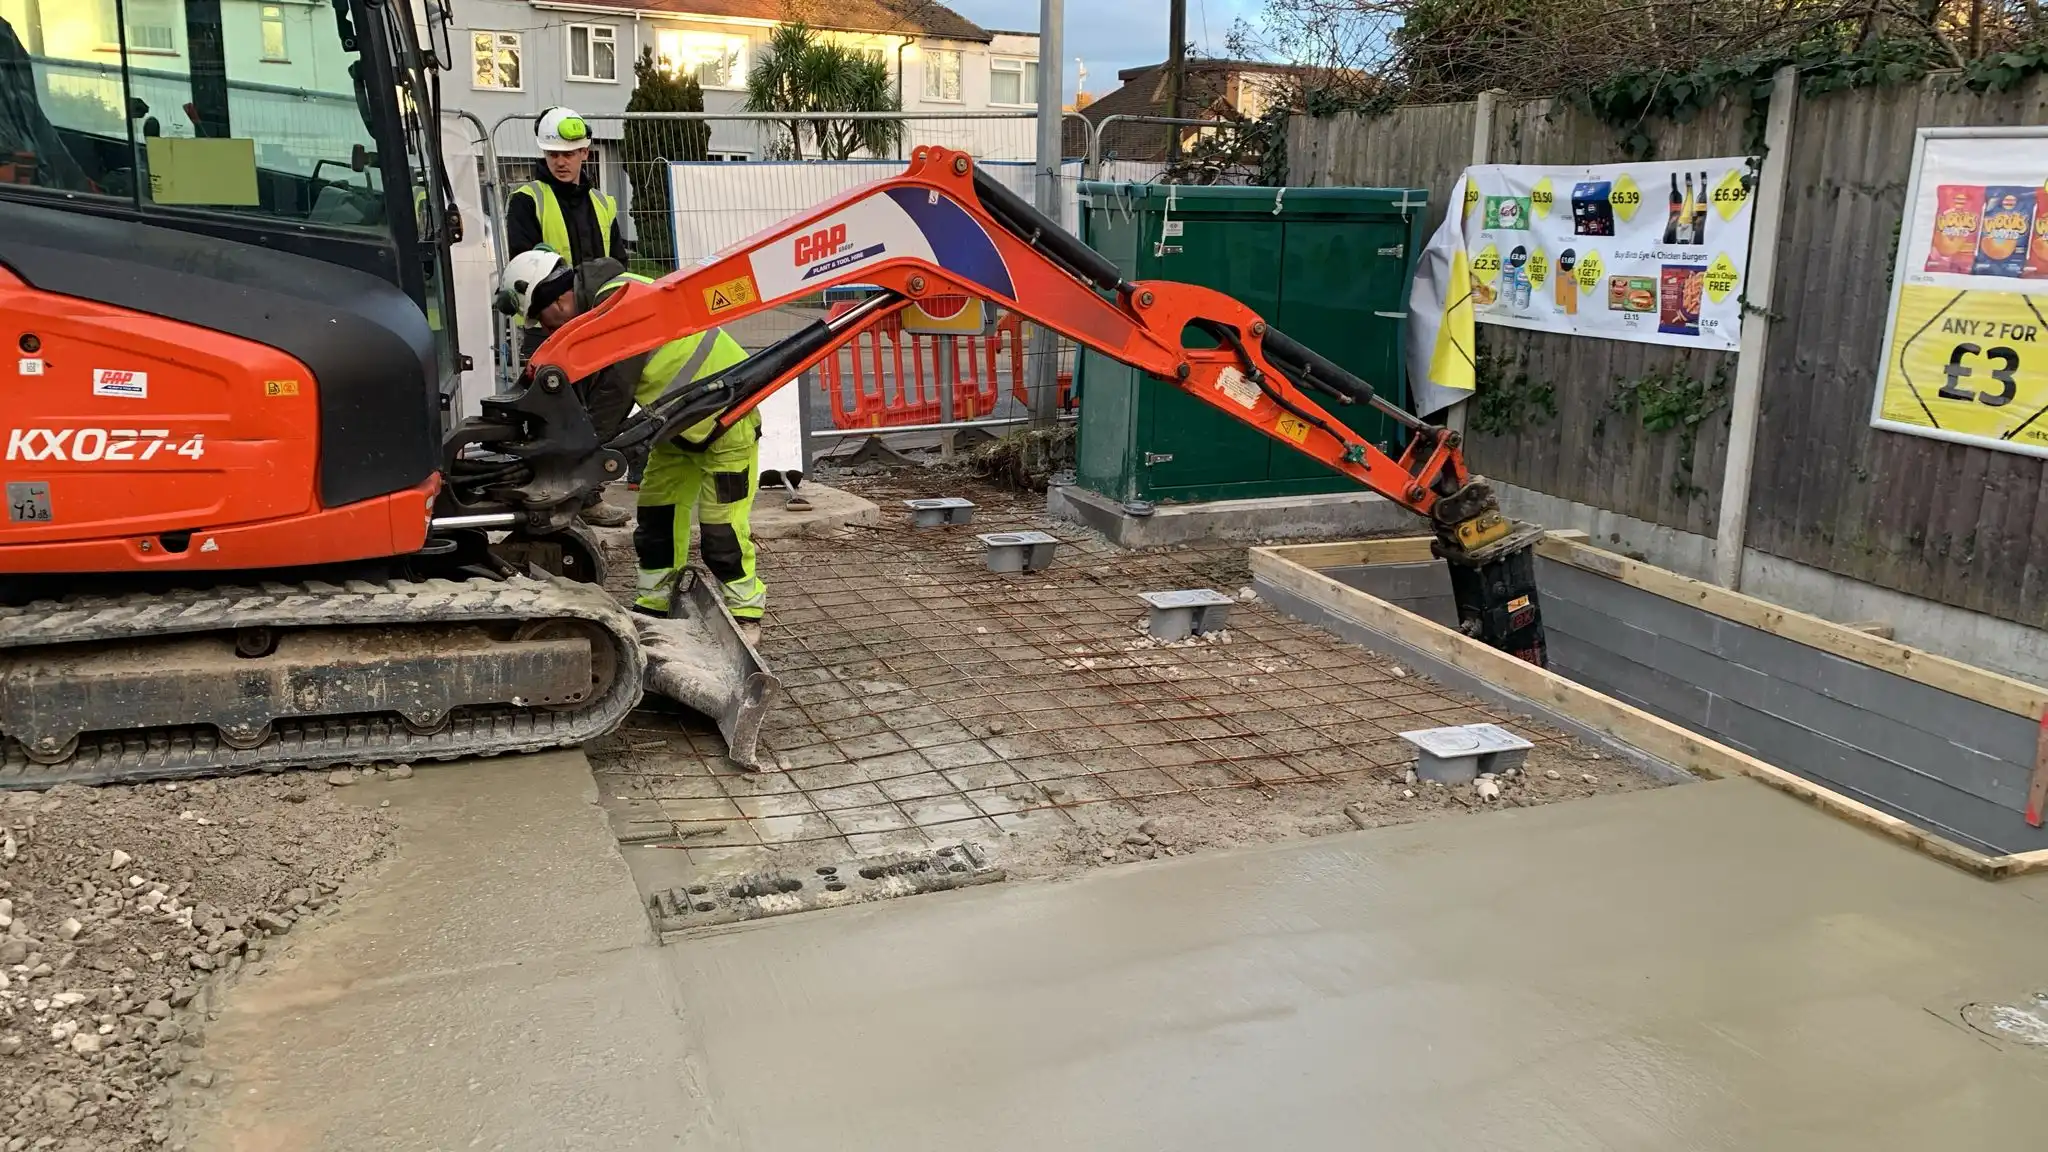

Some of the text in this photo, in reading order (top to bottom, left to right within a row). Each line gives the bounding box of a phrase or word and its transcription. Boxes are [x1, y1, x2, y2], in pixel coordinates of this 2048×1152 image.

[1611, 192, 1640, 204] £6.39
[1714, 188, 1747, 202] £6.99
[795, 223, 846, 267] GAP
[1532, 256, 1544, 264] BUY
[1639, 251, 1650, 260] Eye
[1651, 251, 1656, 259] 4
[1657, 251, 1681, 260] Chicken
[1682, 252, 1709, 262] Burgers
[812, 263, 831, 275] PLANT
[837, 257, 850, 267] TOOL
[850, 252, 864, 262] HIRE
[1583, 259, 1597, 267] BUY
[1533, 265, 1543, 273] GET
[1582, 269, 1596, 277] GET
[1531, 274, 1544, 282] FREE
[1580, 278, 1595, 286] FREE
[1709, 281, 1731, 291] FREE
[1942, 318, 2037, 341] ANY 2 FOR
[1938, 342, 2020, 407] £3
[6, 428, 205, 462] KX027-4
